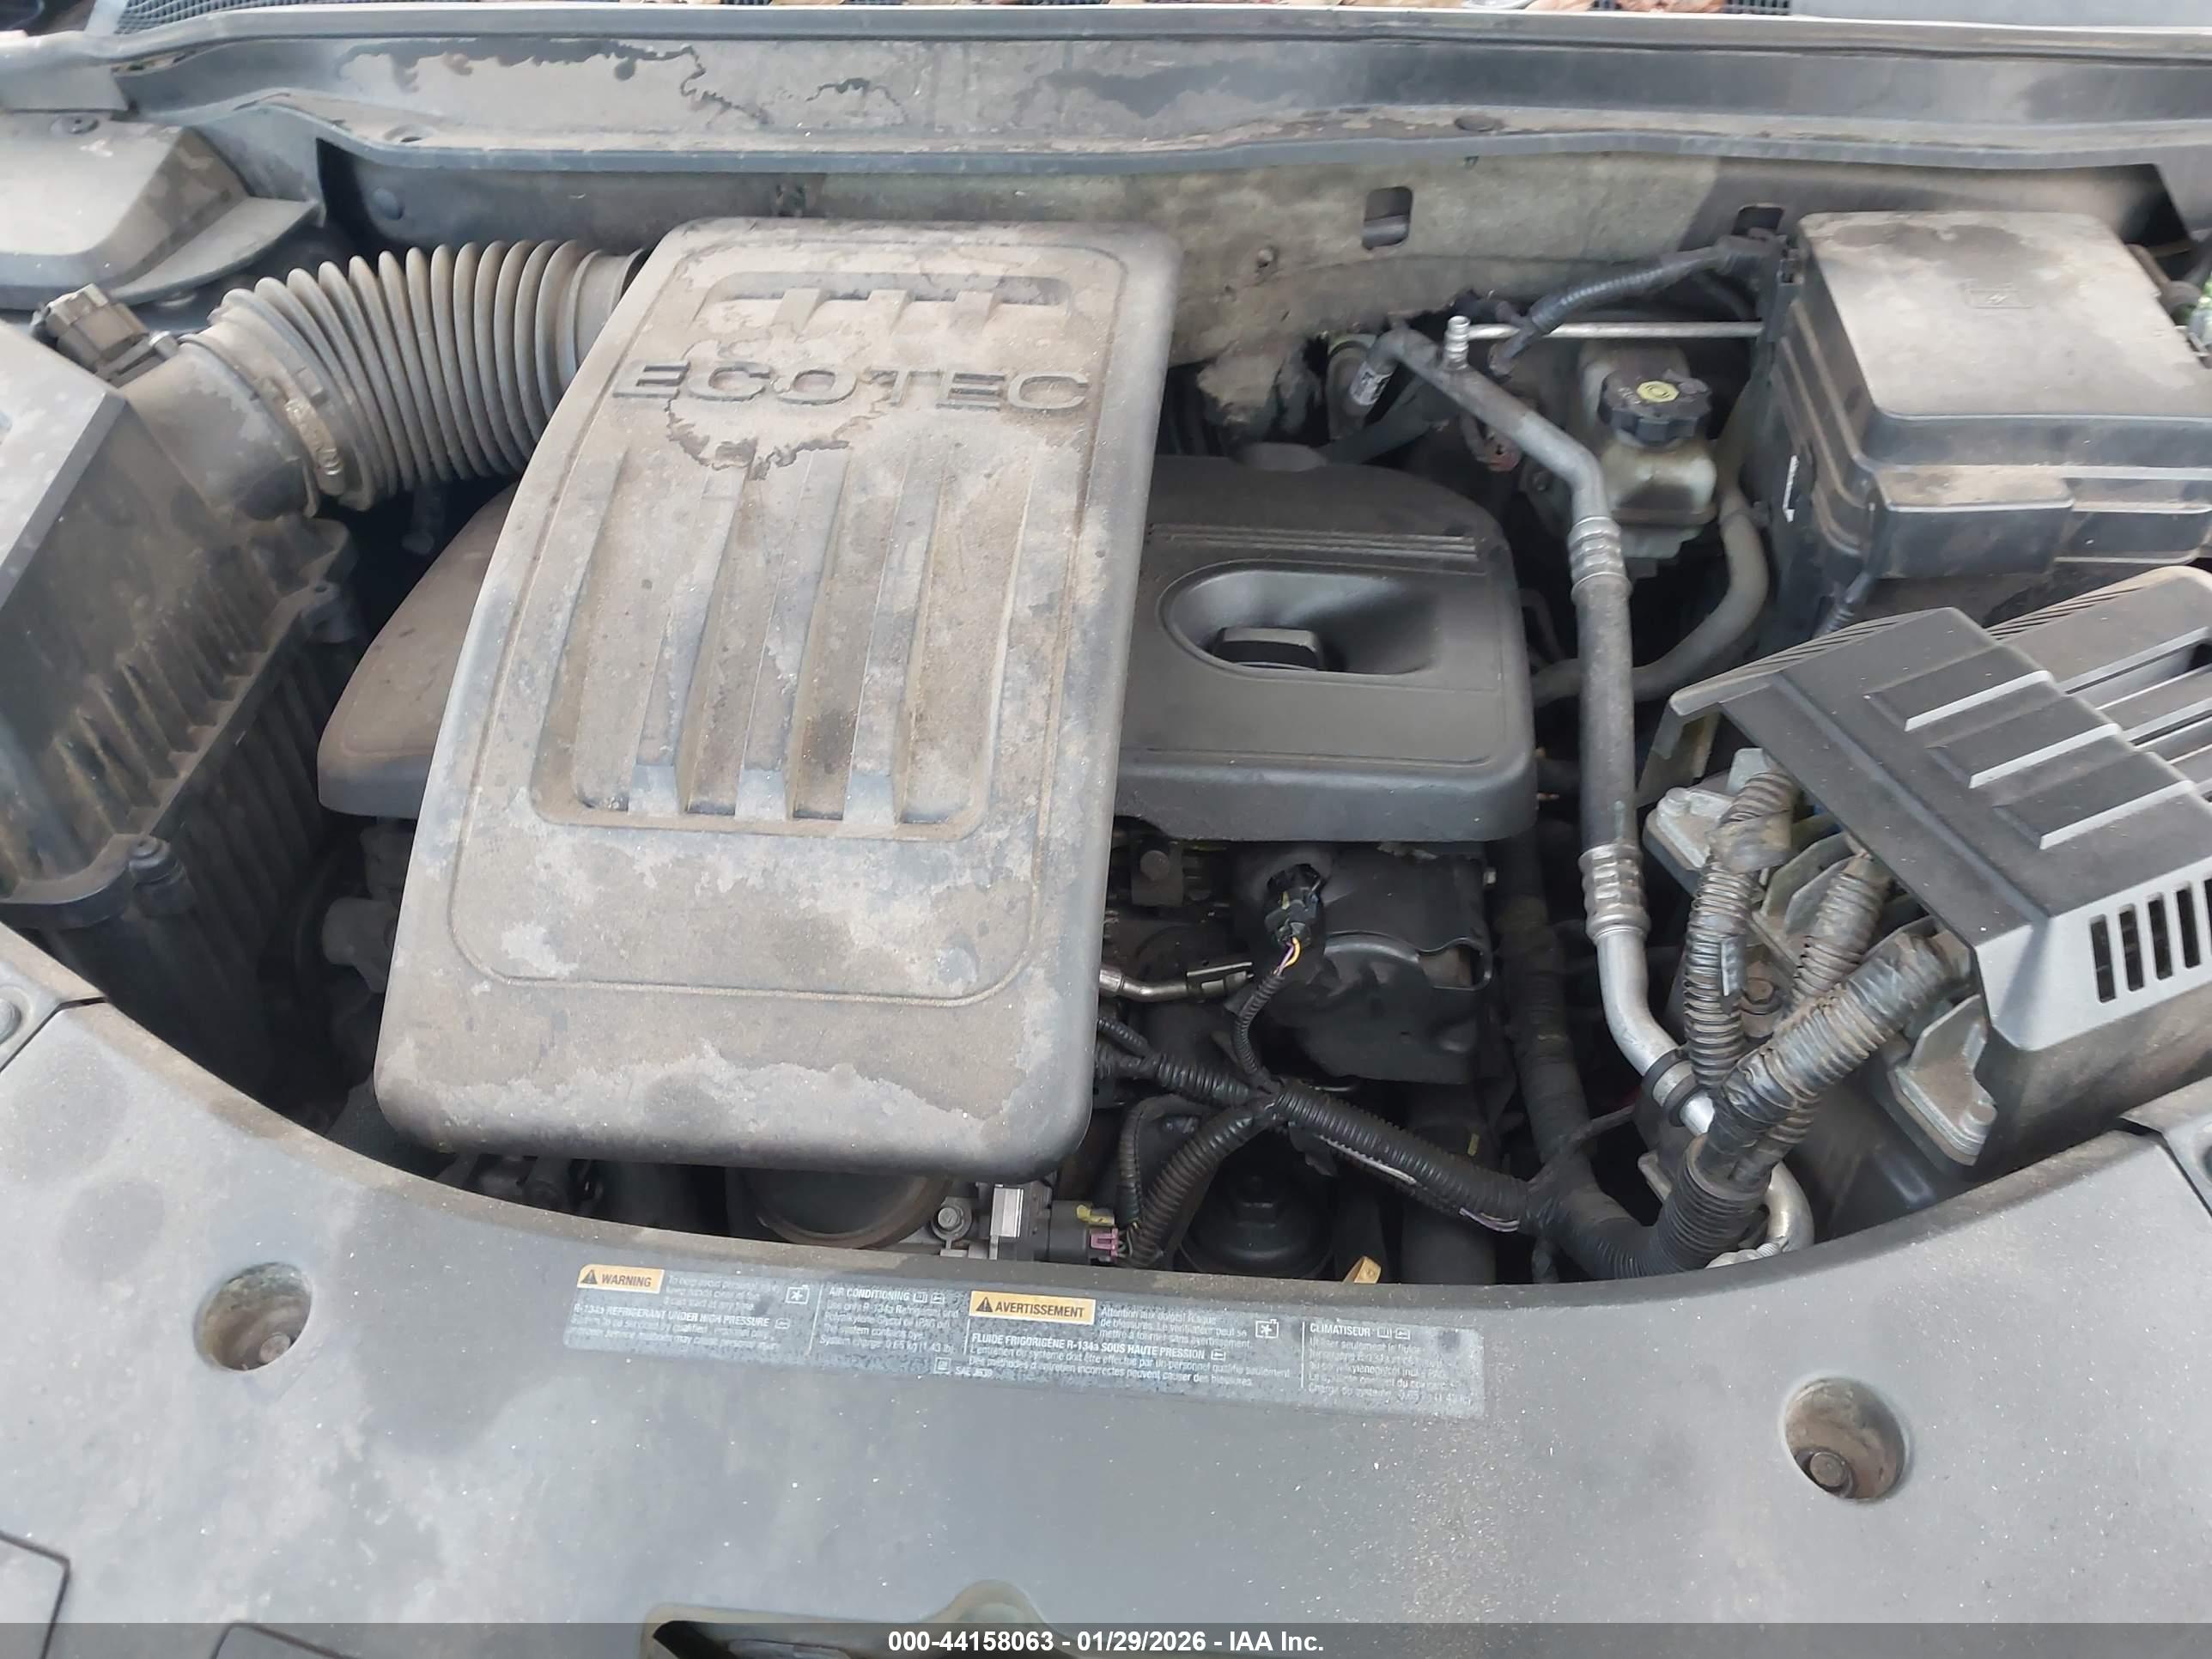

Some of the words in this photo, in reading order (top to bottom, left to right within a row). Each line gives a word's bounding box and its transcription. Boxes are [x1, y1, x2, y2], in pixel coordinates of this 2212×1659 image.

[612, 359, 1090, 412] ECOTEC
[601, 1274, 652, 1287] WARNING
[829, 1286, 845, 1297] AIR
[847, 1289, 910, 1302] CONDITIONING
[606, 1305, 666, 1319] REFRIGERANT
[668, 1311, 697, 1322] UNDER
[700, 1313, 721, 1324] HIGH
[724, 1315, 771, 1328] PRESSURE
[995, 1302, 1085, 1318] AVERTISSEMENT
[1310, 1322, 1371, 1338] CLIMATISEUR
[972, 1333, 1004, 1345] FLUIDE
[1067, 1340, 1099, 1352] R-134a
[1101, 1343, 1126, 1354] SOUS
[1127, 1344, 1158, 1356] HAUTE
[1160, 1347, 1205, 1359] PRESSION
